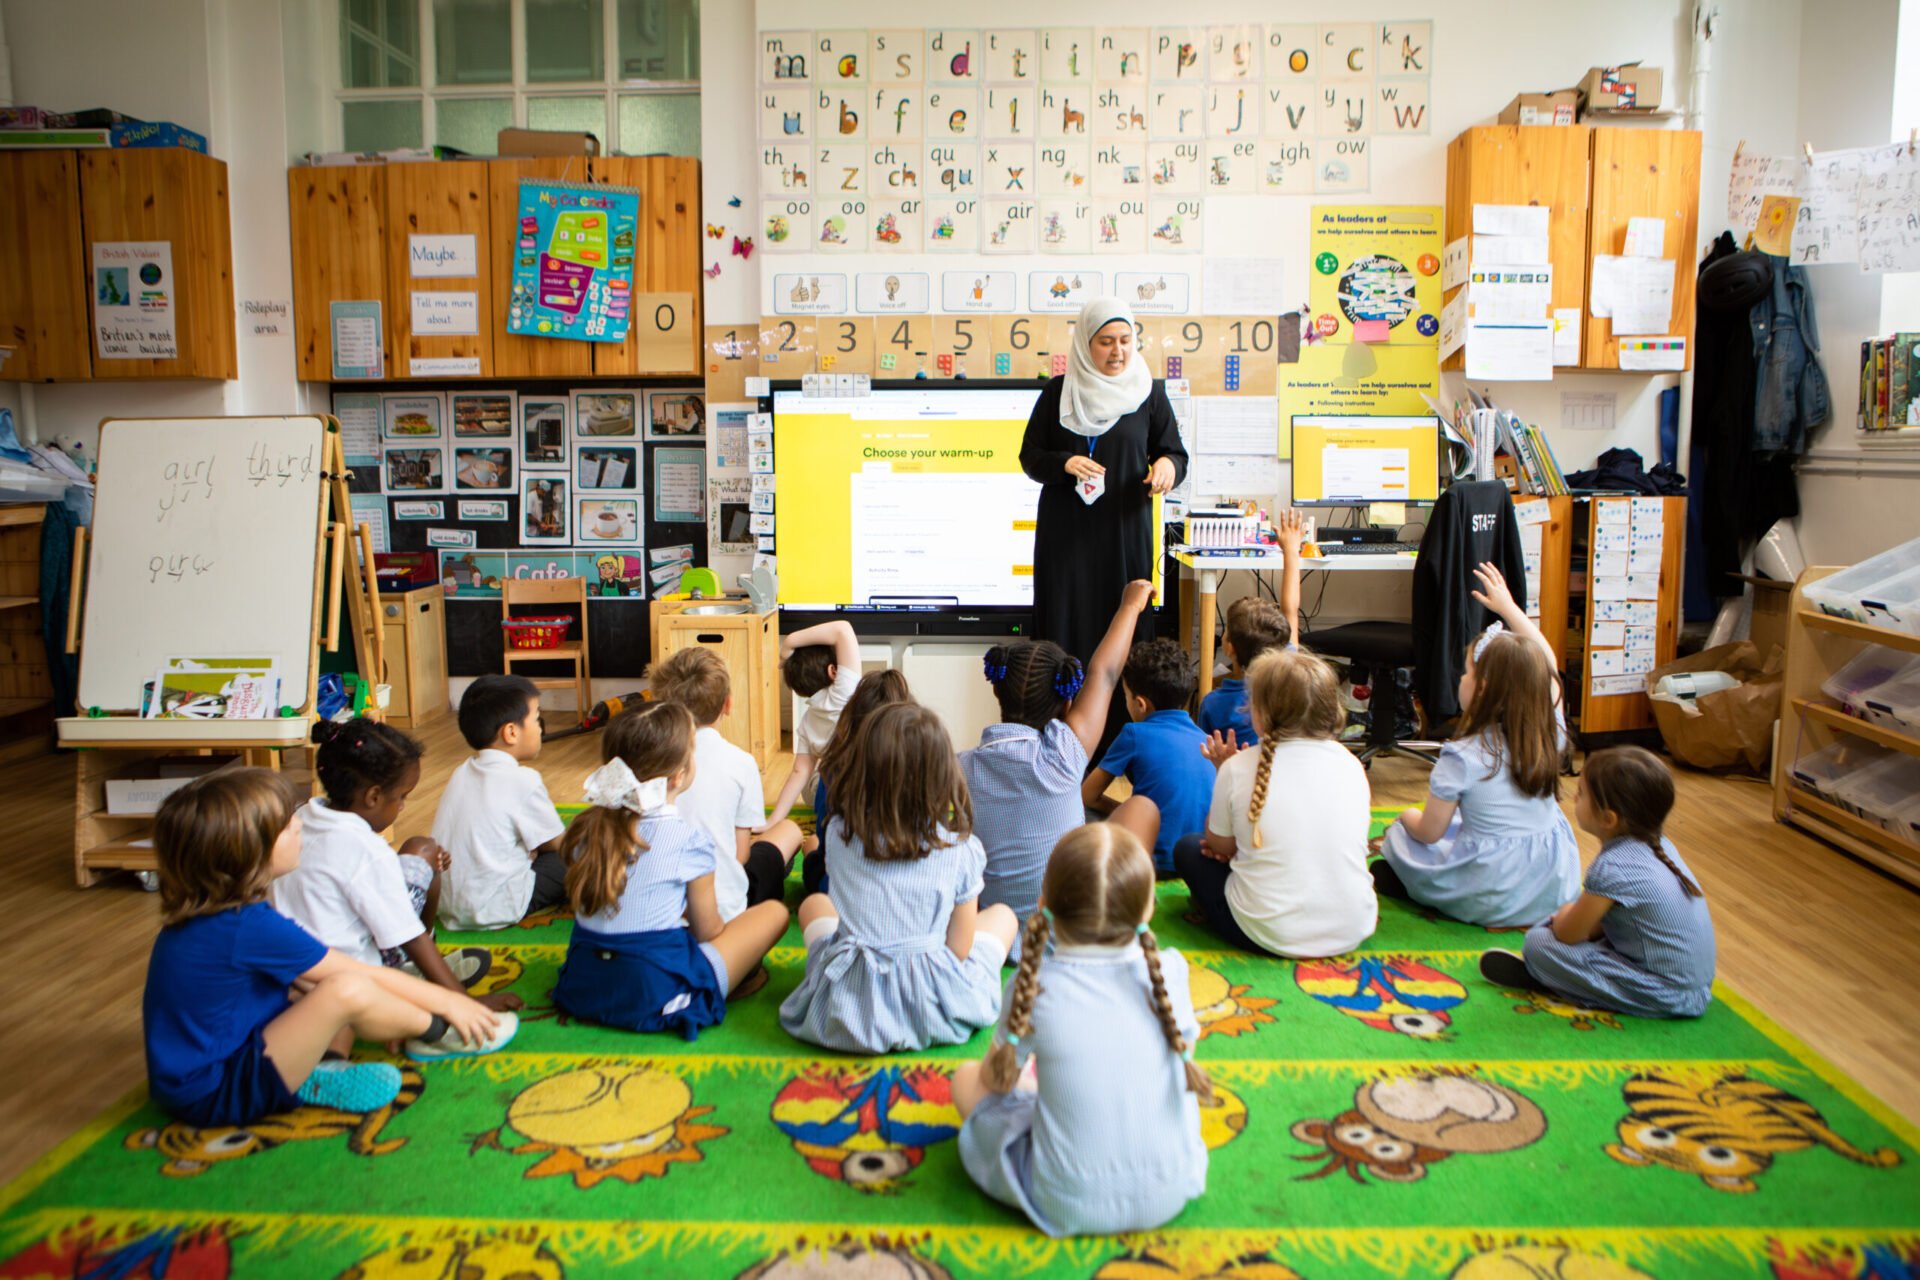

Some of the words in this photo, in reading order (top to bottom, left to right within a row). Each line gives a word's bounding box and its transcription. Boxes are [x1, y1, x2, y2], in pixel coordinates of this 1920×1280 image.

[766, 37, 783, 53] m
[820, 36, 831, 51] a
[877, 32, 885, 50] s
[932, 31, 943, 51] d
[990, 34, 996, 51] t
[1045, 33, 1050, 50] i
[1102, 36, 1113, 49] n
[1159, 36, 1170, 54] p
[1213, 34, 1223, 52] g
[1270, 33, 1281, 46] o
[1326, 32, 1334, 45] c
[1382, 27, 1392, 44] k
[765, 95, 776, 108] u
[819, 90, 830, 108] b
[876, 90, 884, 110] f
[930, 93, 940, 107] e
[989, 90, 994, 108] l
[1043, 90, 1054, 108] h
[1099, 89, 1119, 108] sh
[1157, 92, 1164, 105] r
[1210, 89, 1217, 110] j
[1270, 90, 1280, 102] v
[1325, 89, 1335, 106] y
[1382, 88, 1398, 101] w
[764, 146, 784, 165] th
[821, 151, 829, 163] z
[874, 146, 895, 164] ch
[931, 148, 954, 166] qu
[988, 149, 997, 161] x
[1042, 149, 1066, 167] ng
[1098, 146, 1120, 164] nk
[1175, 144, 1198, 161] ay
[1234, 143, 1254, 156] ee
[1280, 142, 1311, 165] igh
[1336, 142, 1365, 154] ow
[540, 192, 556, 208] My
[786, 202, 810, 215] oo
[841, 201, 865, 214] oo
[901, 200, 921, 214] ar
[956, 200, 976, 214] or
[1007, 203, 1033, 219] air
[1076, 202, 1089, 218] ir
[1120, 201, 1144, 215] ou
[1177, 201, 1200, 220] oy
[416, 297, 431, 307] Tell
[655, 304, 675, 331] 0
[725, 330, 742, 360] 1
[779, 321, 797, 352] 2
[837, 322, 856, 352] 3
[891, 320, 913, 350] 4
[953, 320, 973, 351] 5
[1009, 319, 1030, 350] 6
[1182, 322, 1202, 352] 9
[1230, 321, 1274, 352] 10
[863, 447, 907, 457] Choose
[911, 450, 936, 460] your
[941, 450, 993, 460] warm-up
[1472, 514, 1496, 532] STAFF
[515, 562, 568, 579] Cafe
